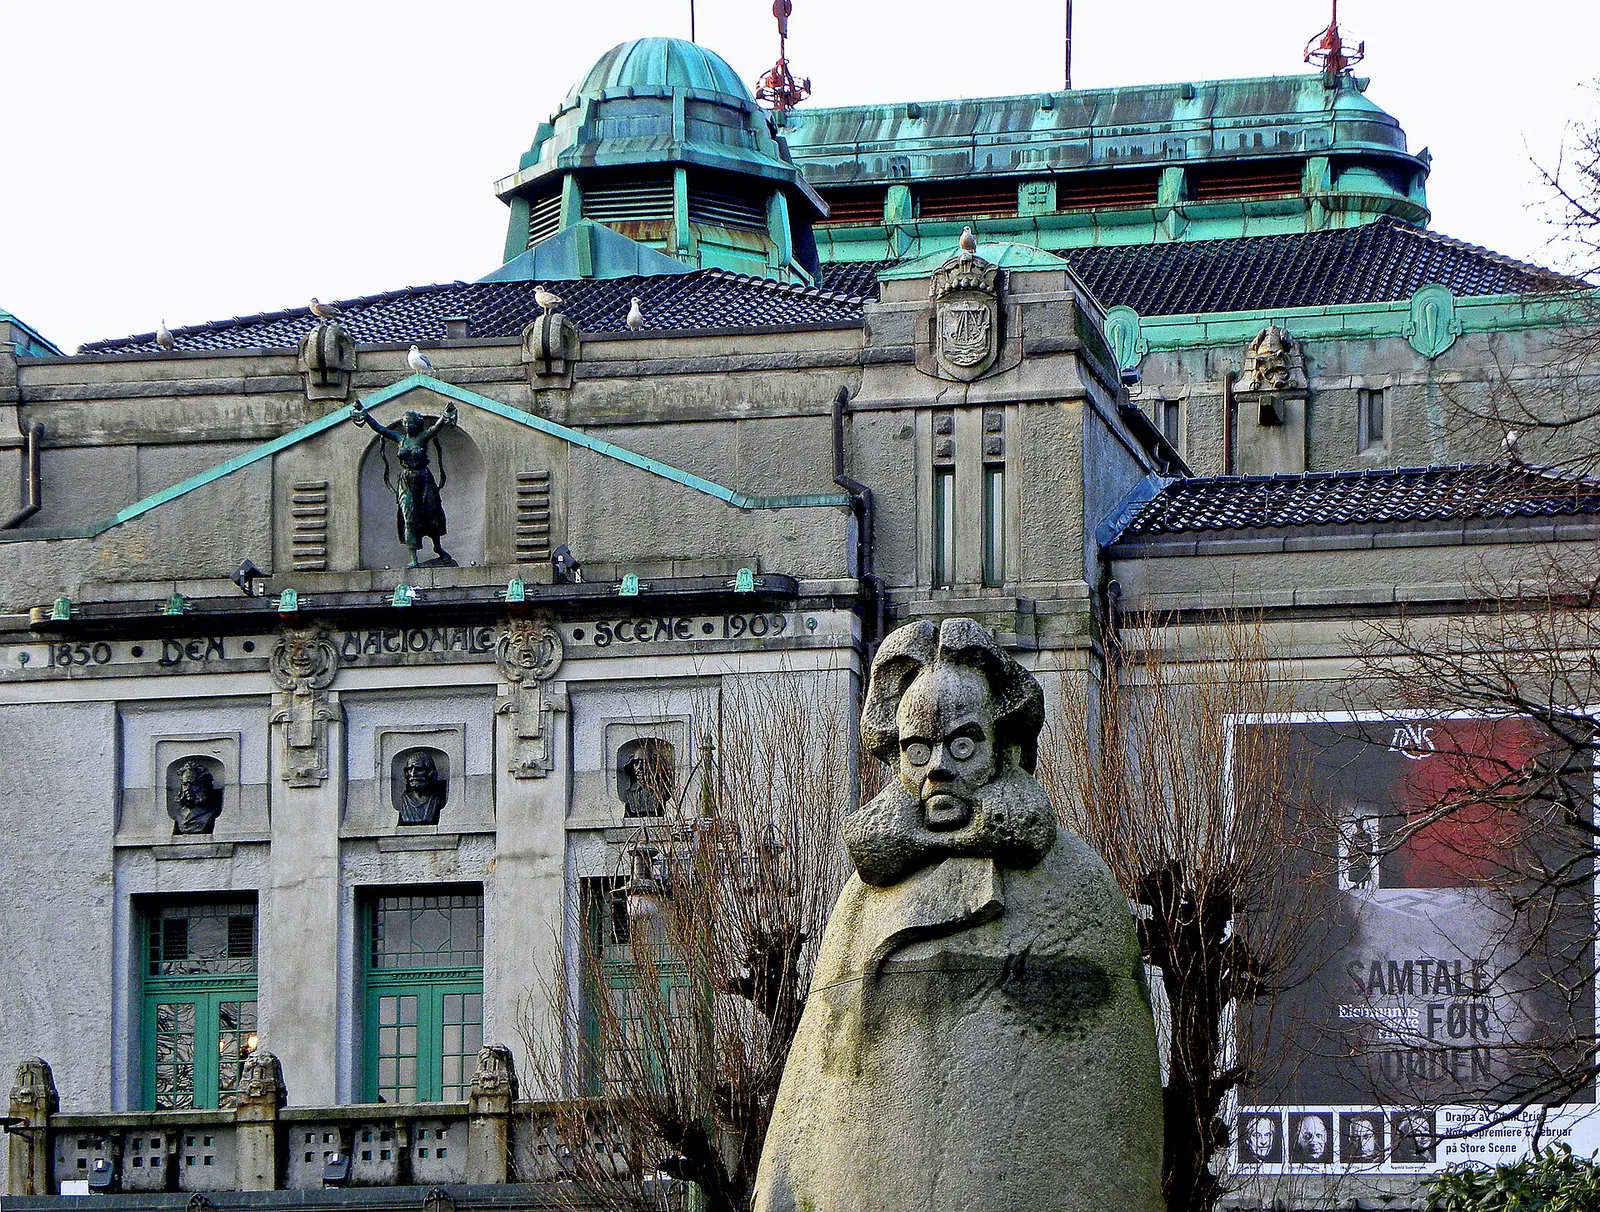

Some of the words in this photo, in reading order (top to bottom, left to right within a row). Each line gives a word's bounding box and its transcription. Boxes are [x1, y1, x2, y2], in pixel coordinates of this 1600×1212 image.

[47, 642, 112, 668] 1850
[158, 636, 225, 667] DEN
[593, 617, 694, 647] SCENE
[722, 613, 788, 639] 1909
[1348, 959, 1489, 996] SAMTALE
[1427, 1003, 1490, 1039] FØR
[1445, 1111, 1476, 1122] Drama
[1522, 1111, 1544, 1122] Pric
[1537, 1127, 1572, 1137] ebruar
[1445, 1142, 1457, 1155] på
[1460, 1143, 1485, 1153] Store
[1488, 1143, 1517, 1153] Scene
